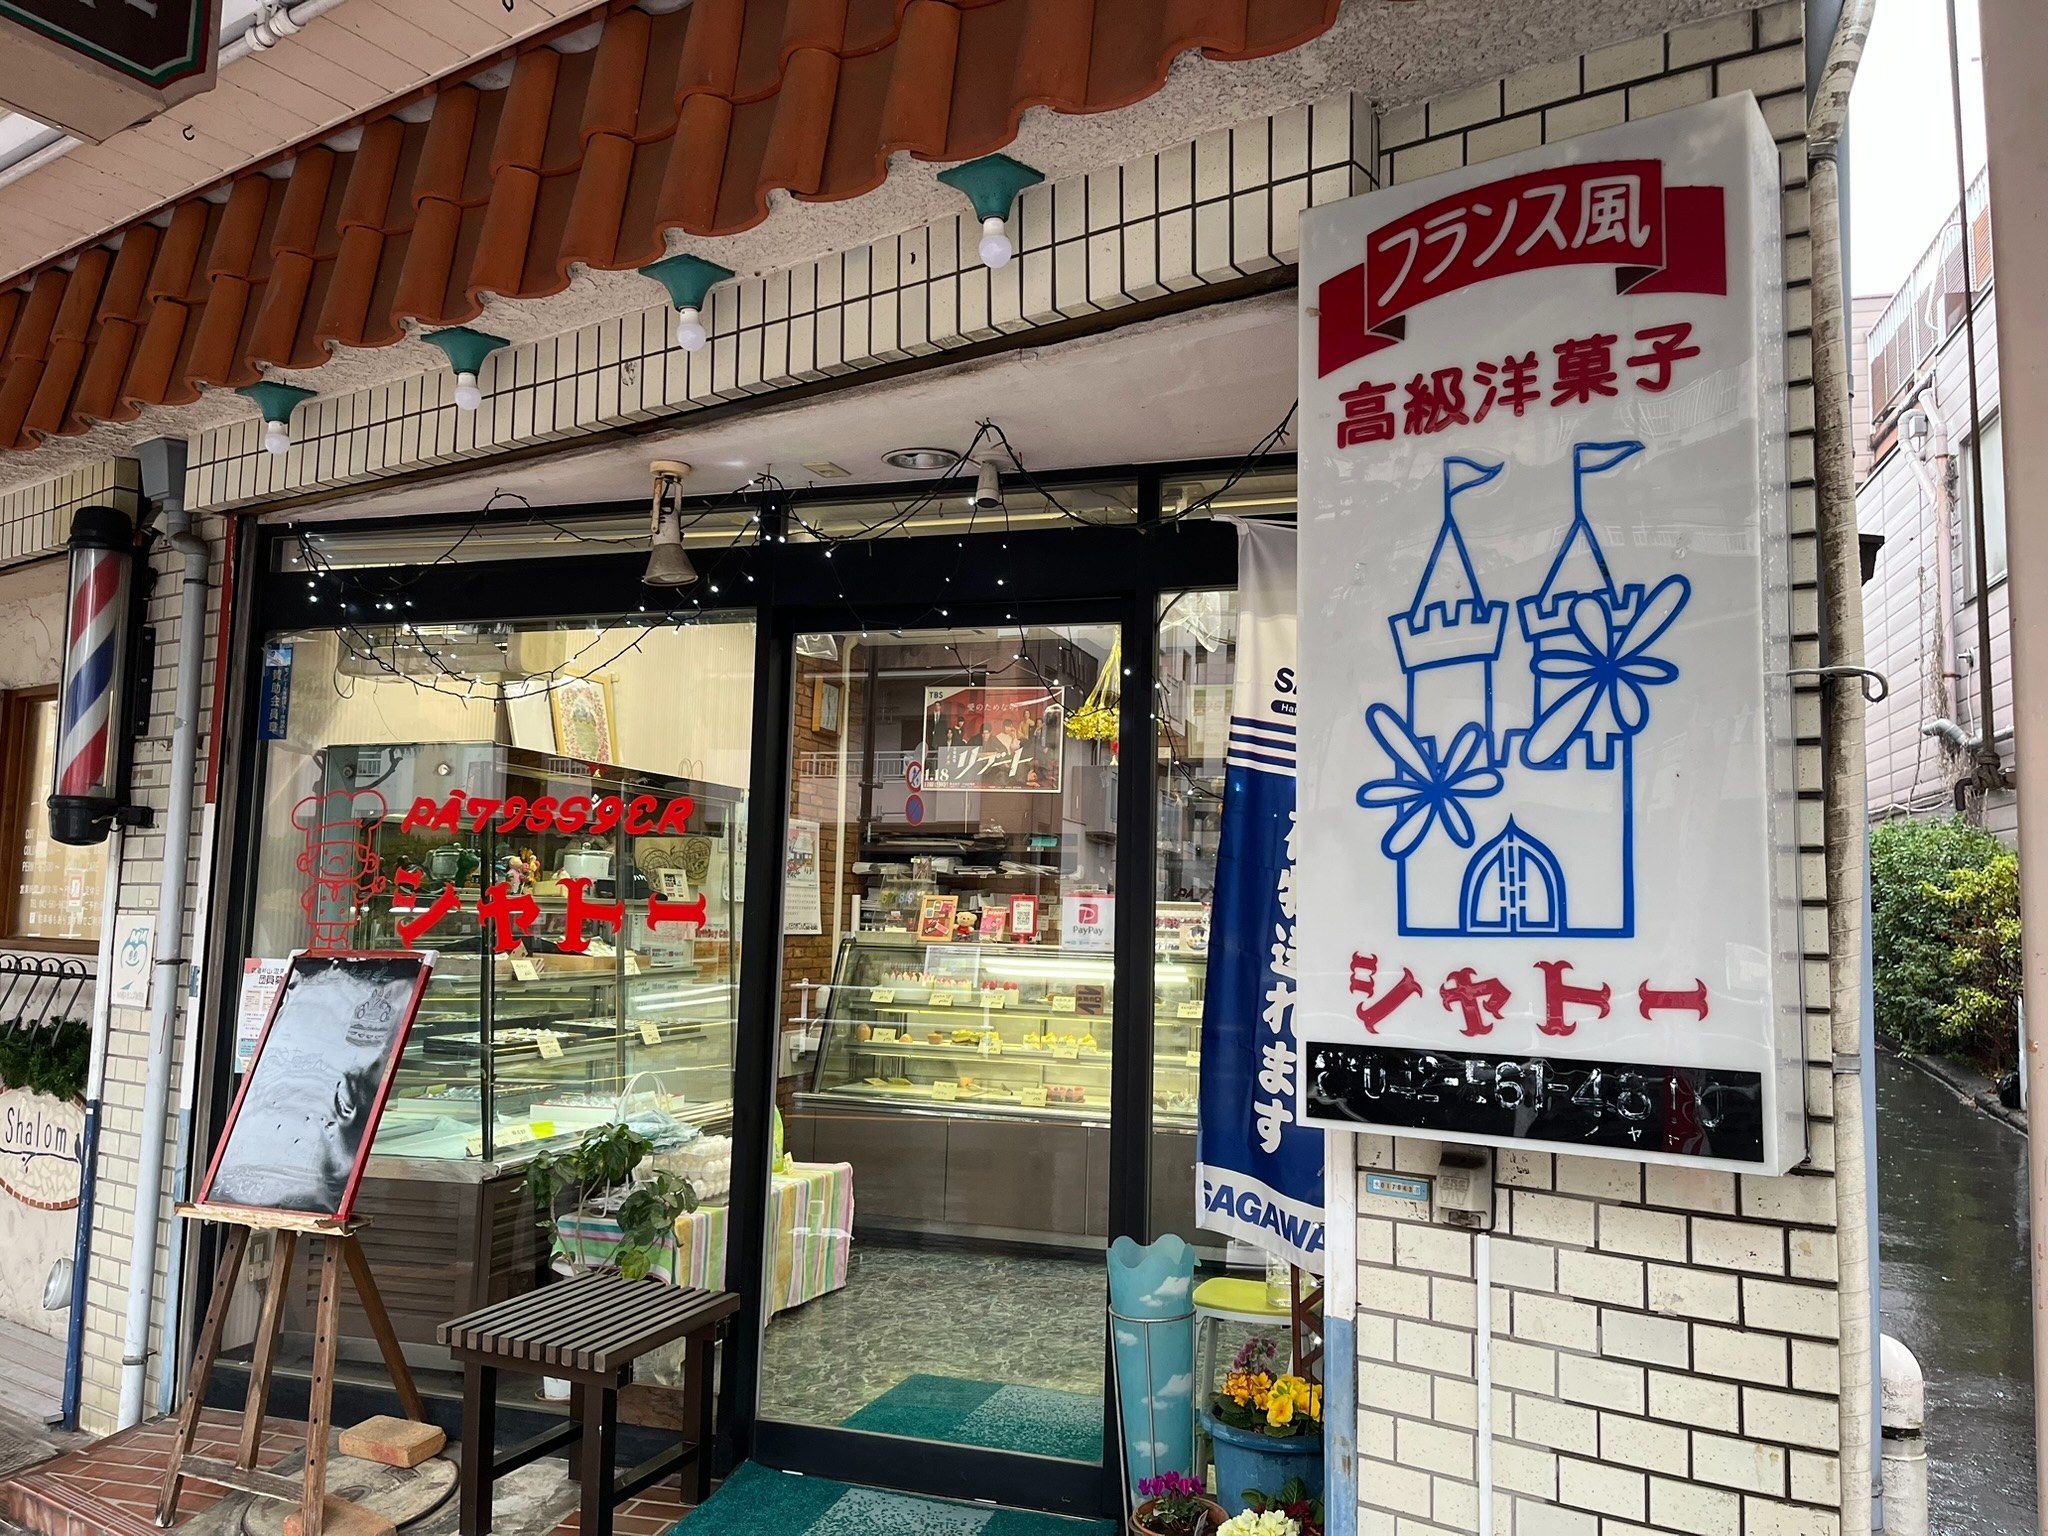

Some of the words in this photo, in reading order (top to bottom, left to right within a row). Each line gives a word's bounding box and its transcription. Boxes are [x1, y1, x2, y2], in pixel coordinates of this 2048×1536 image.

[1376, 173, 1651, 307] フランス風
[1336, 322, 1700, 449] 高級洋菓子
[929, 691, 944, 699] TBS
[924, 768, 950, 781] 1.18
[954, 746, 1034, 780] リブート
[392, 867, 707, 953] シャトー
[1072, 925, 1104, 936] PayPay
[1348, 950, 1709, 1038] シャトー
[5, 1107, 67, 1154] Shalom
